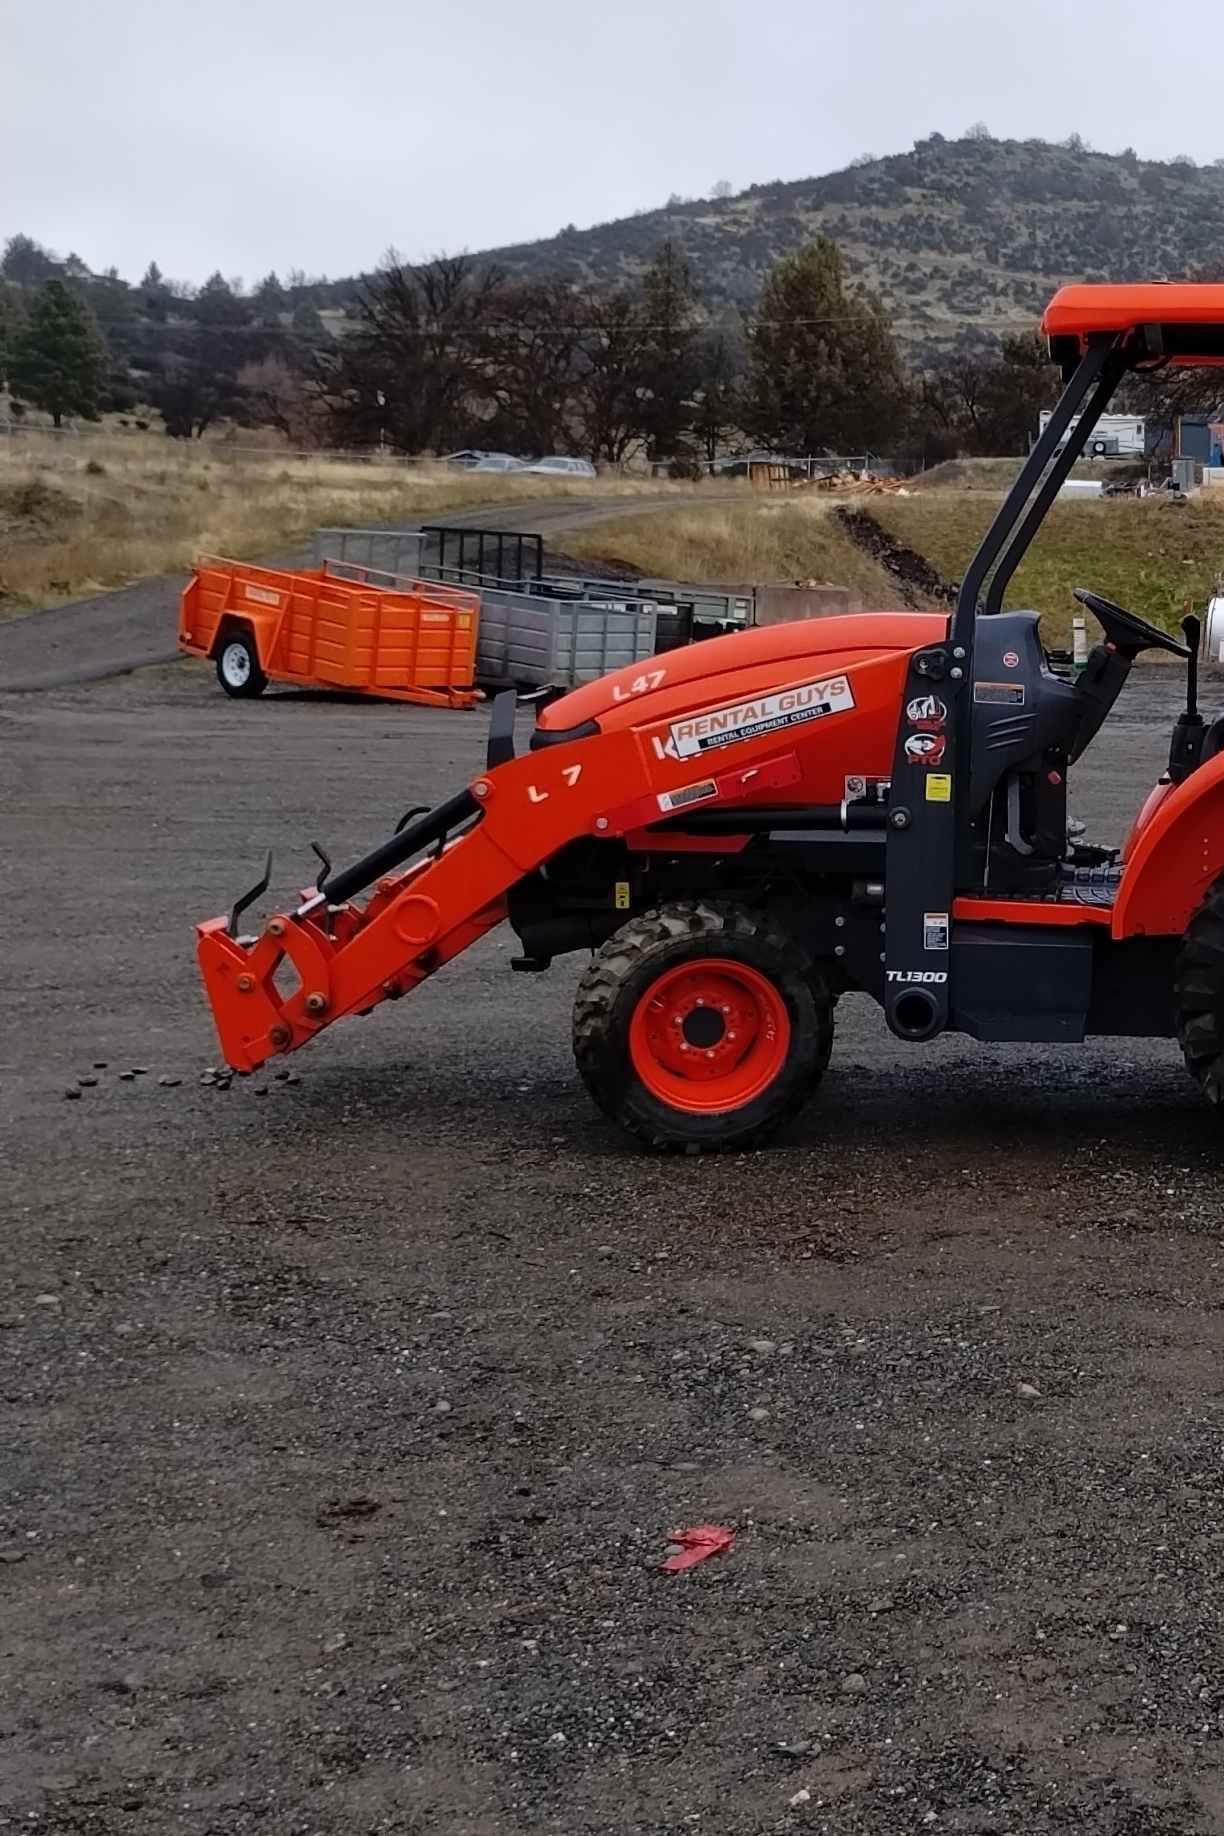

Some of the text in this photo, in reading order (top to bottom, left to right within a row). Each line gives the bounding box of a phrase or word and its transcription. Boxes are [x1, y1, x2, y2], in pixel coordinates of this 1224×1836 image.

[612, 670, 667, 701] L47
[677, 680, 846, 742] RENTAL GUYS
[707, 706, 824, 746] RENTAL EQUIPMENT CENTER
[886, 970, 948, 983] TL1300
